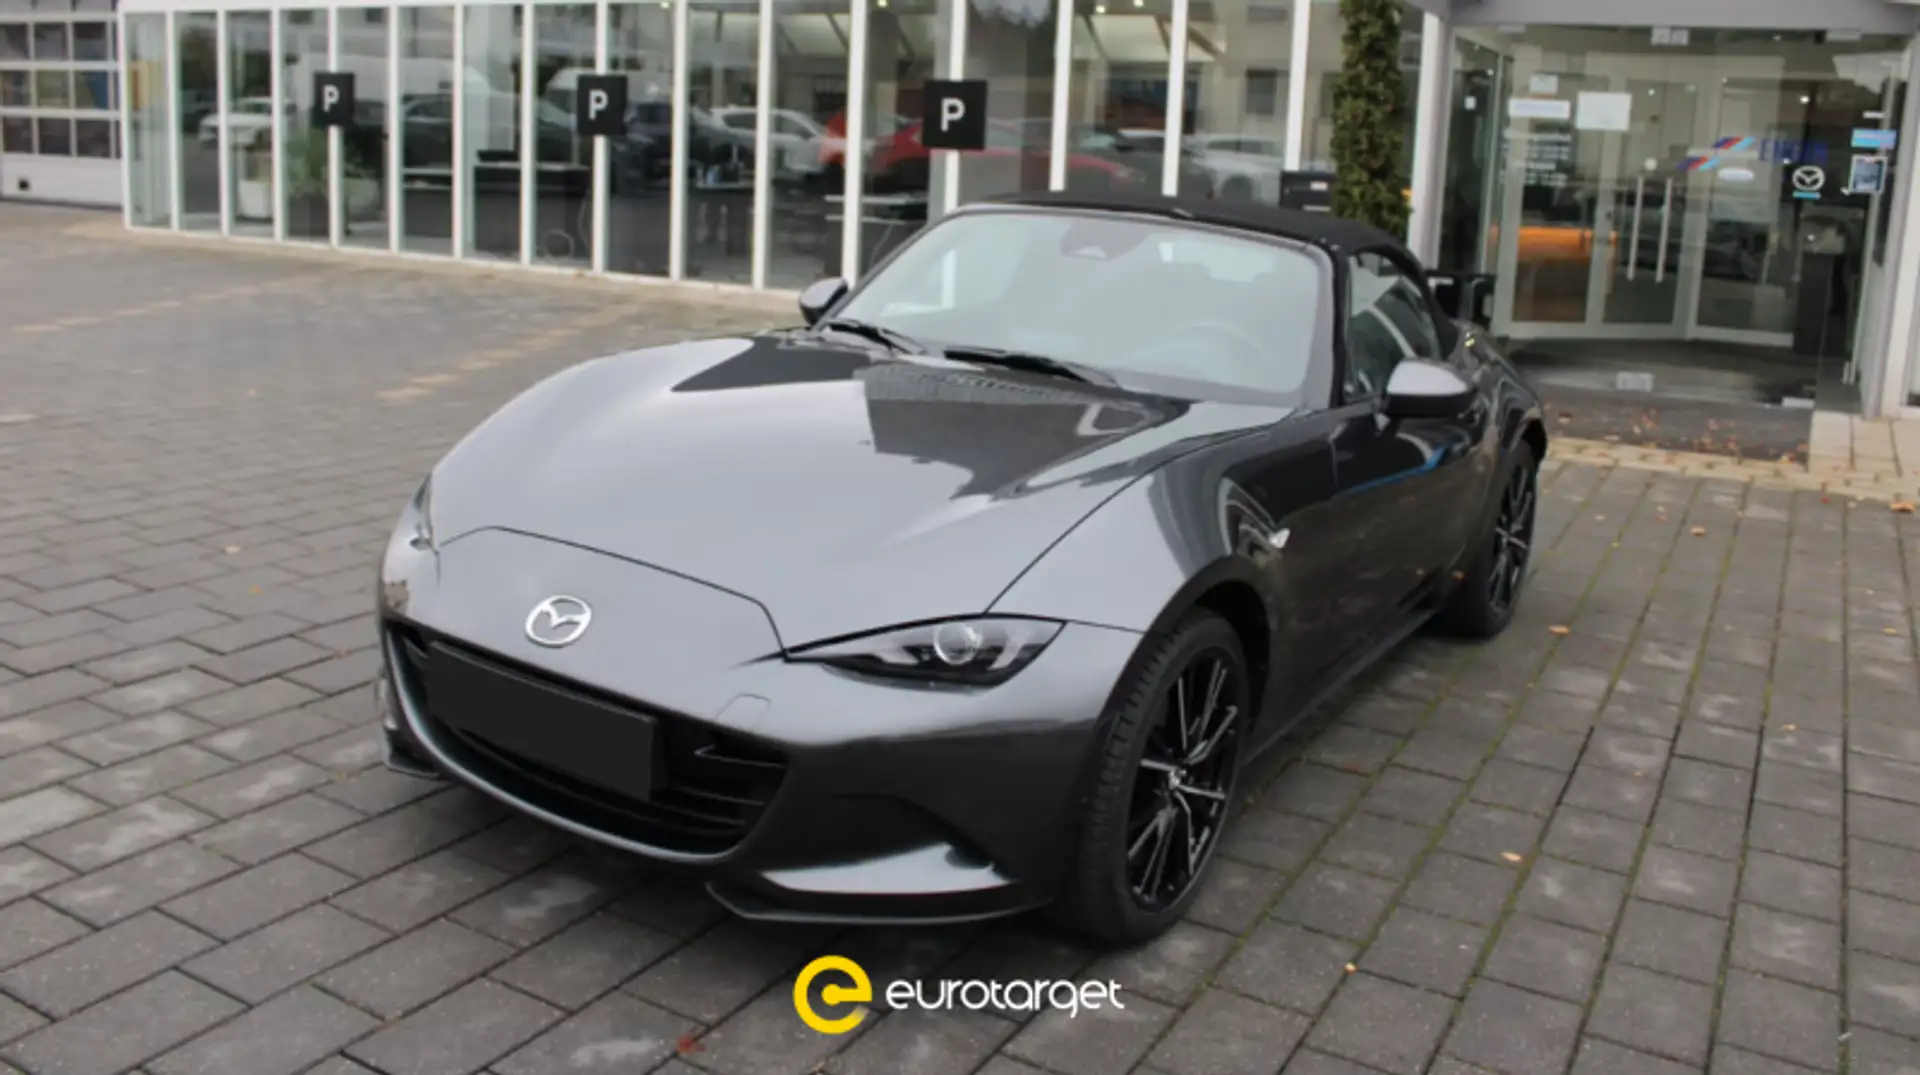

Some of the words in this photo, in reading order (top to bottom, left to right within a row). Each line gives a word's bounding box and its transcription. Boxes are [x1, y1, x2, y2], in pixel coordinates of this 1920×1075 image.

[322, 84, 340, 112] P
[588, 89, 608, 120] P
[940, 97, 966, 132] P
